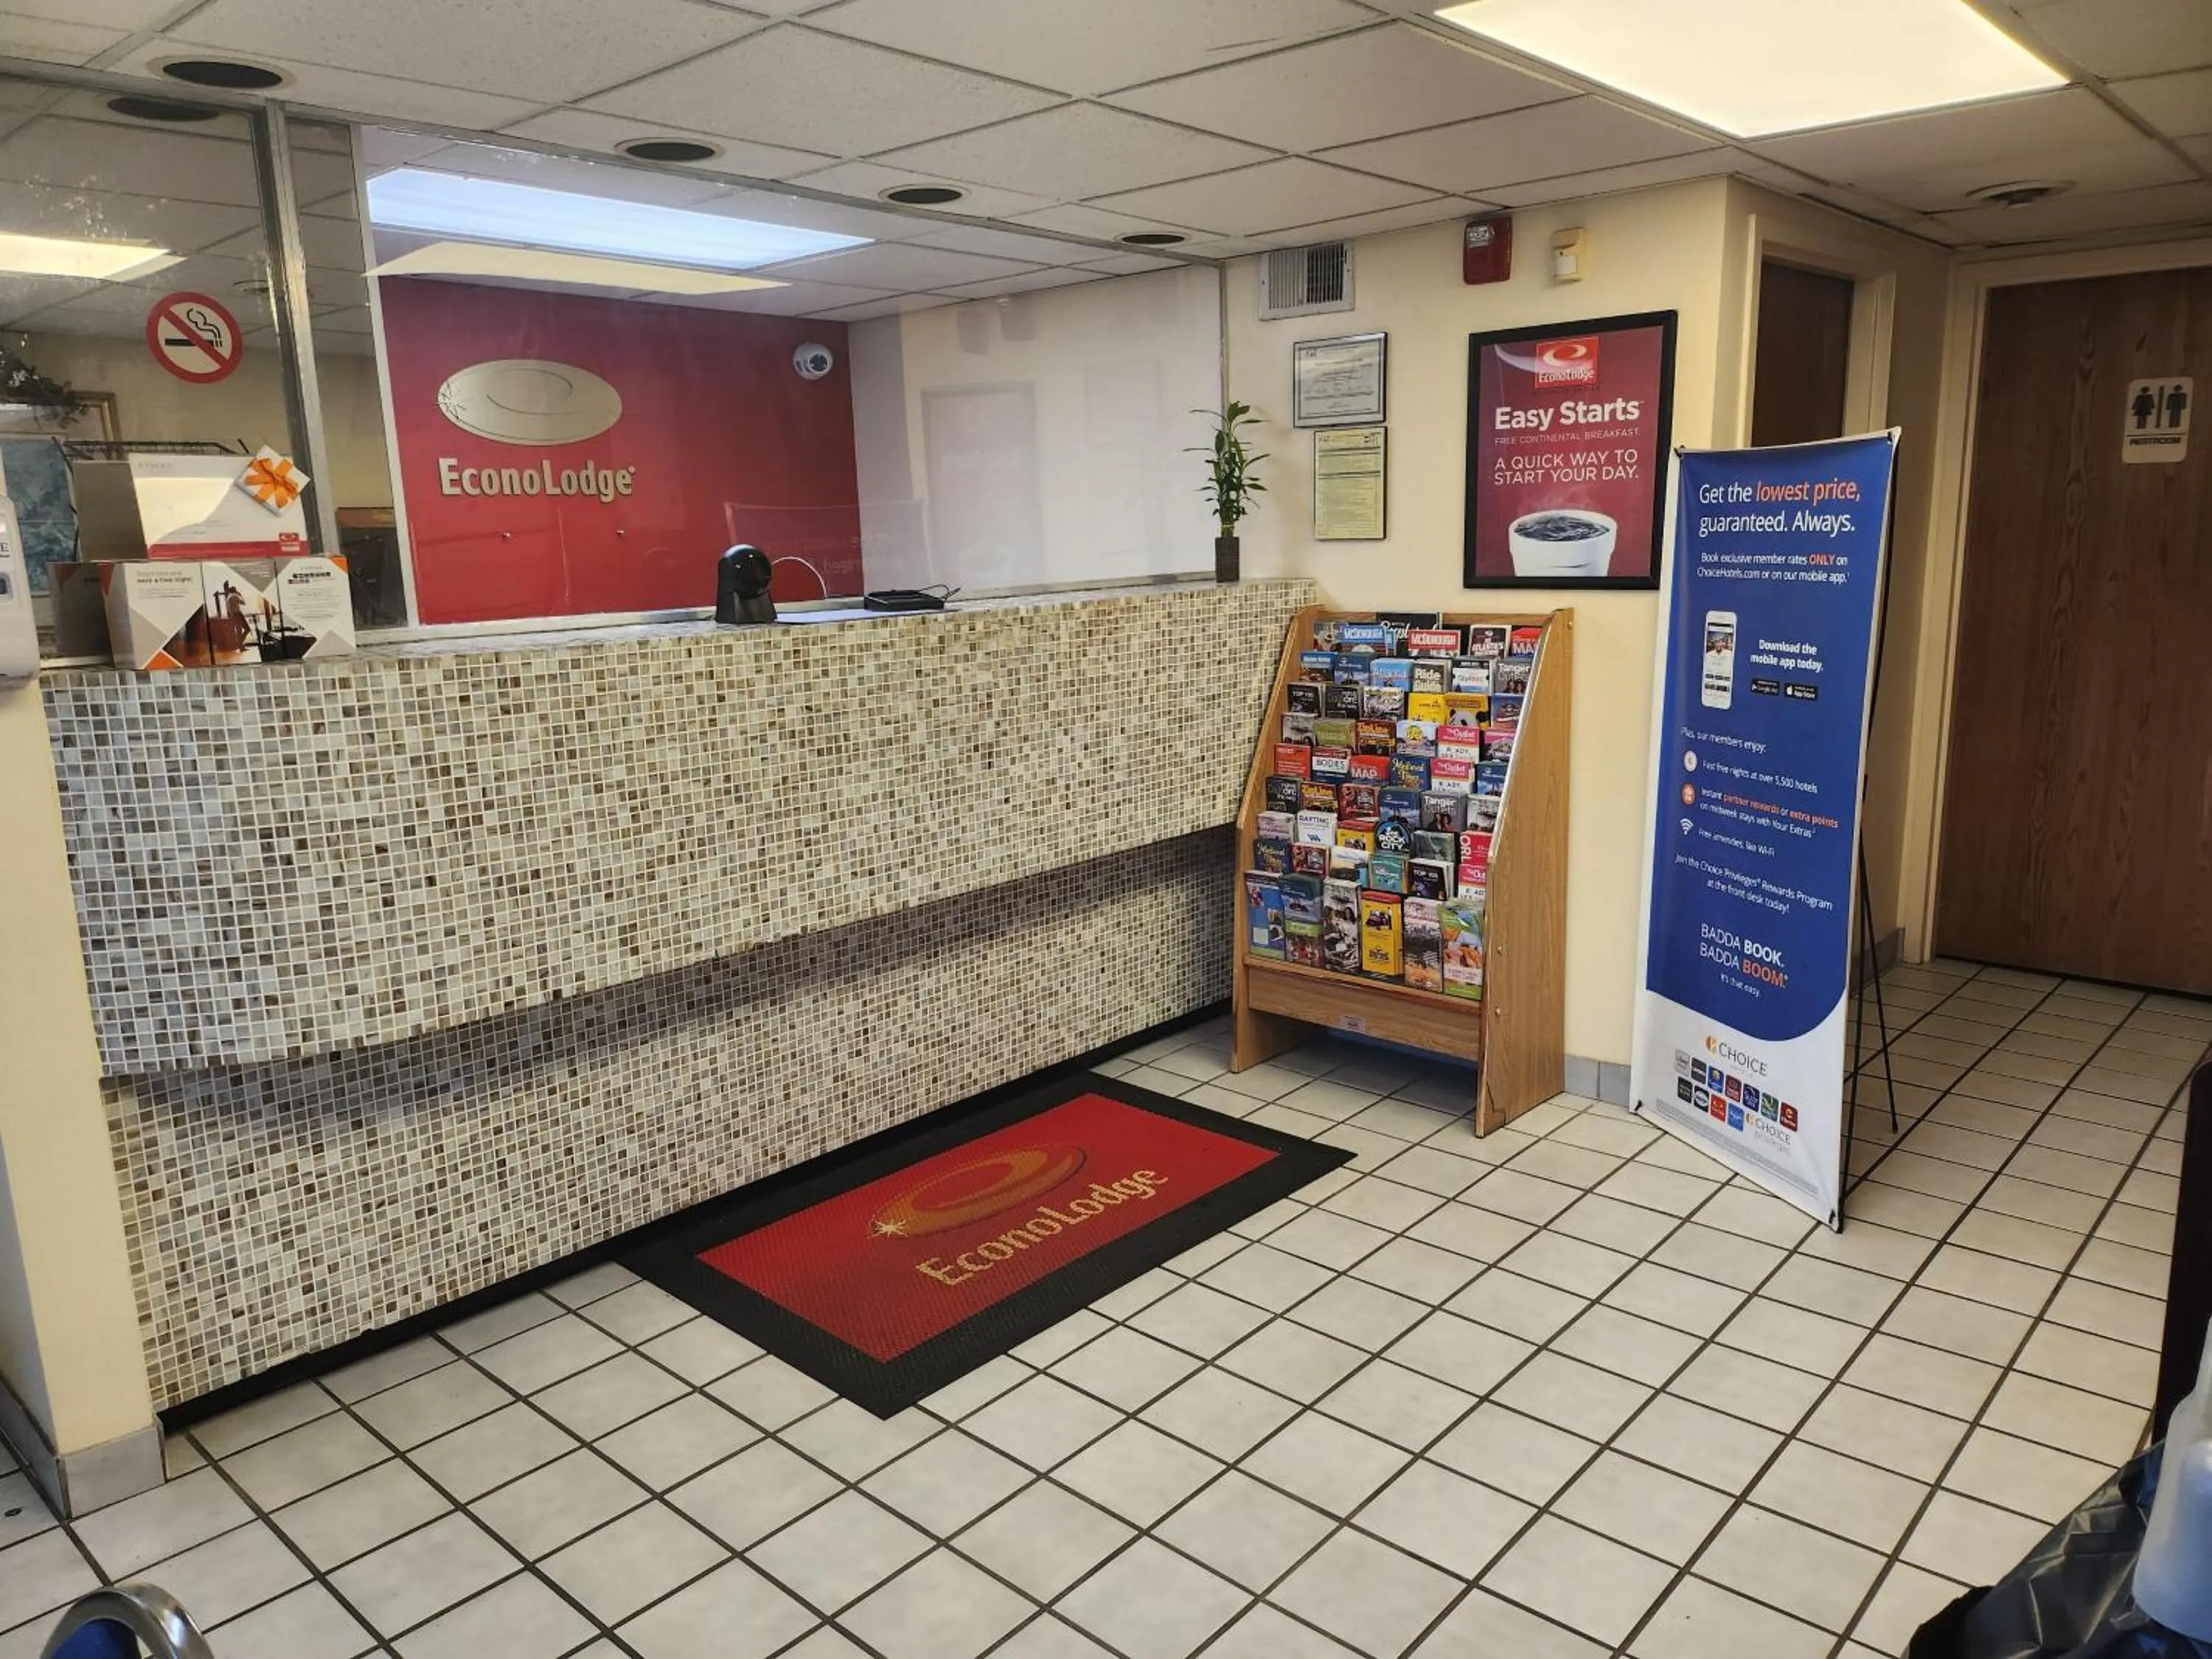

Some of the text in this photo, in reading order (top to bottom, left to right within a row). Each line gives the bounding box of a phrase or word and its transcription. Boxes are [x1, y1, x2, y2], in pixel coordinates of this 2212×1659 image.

[1538, 366, 1596, 383] EconoLodge
[1495, 397, 1641, 431] Easy Starts
[1495, 437, 1519, 445] FREE
[1520, 433, 1581, 445] CONTINENTAL
[1495, 449, 1638, 470] A QUICK WAY TO
[439, 457, 633, 503] EconoLodge
[1494, 465, 1640, 486] START YOUR DAY.
[1699, 477, 1861, 507] Get the lowest price,
[1698, 509, 1856, 538] guaranteed. Always.
[1701, 552, 1848, 566] Book exclusive member rates ONLY on
[1697, 566, 1761, 580] ChoiceHotels.com
[1761, 571, 1770, 580] or
[1772, 571, 1783, 580] on
[1784, 571, 1798, 581] our
[1798, 571, 1828, 582] mobile
[1513, 641, 1535, 654] MA
[1758, 639, 1818, 655] Download the
[1414, 667, 1441, 680] Ride
[1750, 653, 1823, 672] mobile app today.
[1413, 679, 1441, 692] Guide
[1697, 731, 1708, 742] our
[1709, 734, 1743, 748] members
[1744, 741, 1767, 754] enjoy:
[1351, 767, 1378, 779] MAP
[1702, 759, 1818, 794] Fast free nights at over 5,500 hotels
[1425, 796, 1458, 807] Tanger
[1701, 787, 1722, 800] Instant
[1722, 794, 1750, 807] partner
[1780, 807, 1790, 816] or
[1790, 810, 1811, 823] extra
[1812, 814, 1839, 828] points
[1699, 801, 1708, 811] on
[1708, 804, 1738, 818] midweek
[1739, 813, 1756, 824] stays
[1756, 817, 1772, 827] with
[1772, 819, 1789, 832] Your
[1378, 834, 1406, 844] ROCK
[1381, 841, 1404, 850] CITY
[1698, 827, 1712, 838] Free
[1745, 841, 1757, 852] like
[1674, 852, 1688, 864] Join
[1688, 856, 1700, 869] the
[1700, 860, 1724, 877] Choice
[1761, 880, 1795, 900] Rewards
[1796, 890, 1833, 912] Program
[1707, 880, 1790, 915] at the front desk today!
[1700, 942, 1739, 970] BADDA
[1701, 922, 1785, 969] BADDA BOOK.
[1720, 972, 1761, 998] It's that easy.
[1719, 1042, 1769, 1077] CHOICE
[1756, 1117, 1792, 1145] CHOICE
[915, 1167, 1169, 1286] EconoLodge
